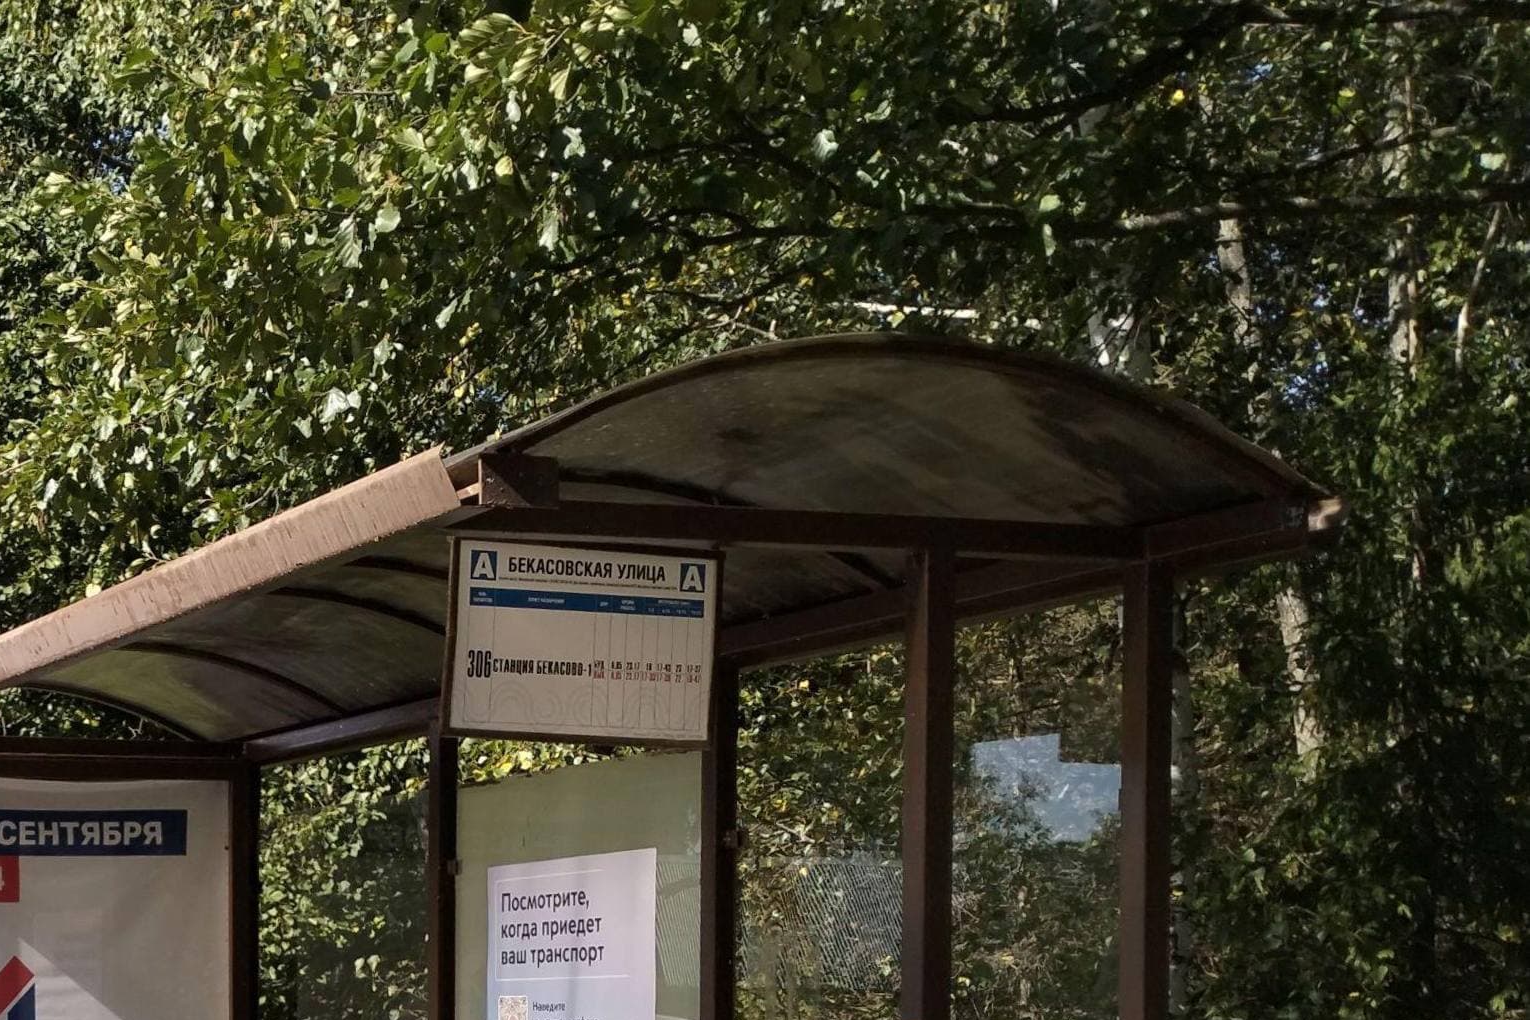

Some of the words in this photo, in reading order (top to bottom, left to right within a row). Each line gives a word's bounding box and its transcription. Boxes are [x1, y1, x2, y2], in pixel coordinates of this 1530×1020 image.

[508, 556, 612, 578] БЕКАСОВСКАЯ
[617, 564, 666, 584] УЛИЦА
[467, 650, 492, 678] 306
[493, 658, 534, 675] СТАНЦИЯ
[501, 890, 590, 913] Посмотрите,
[501, 922, 538, 940] когда
[542, 917, 602, 940] приедет
[501, 950, 527, 966] ваш
[530, 946, 605, 969] транспорт
[532, 1001, 566, 1012] Наведите
